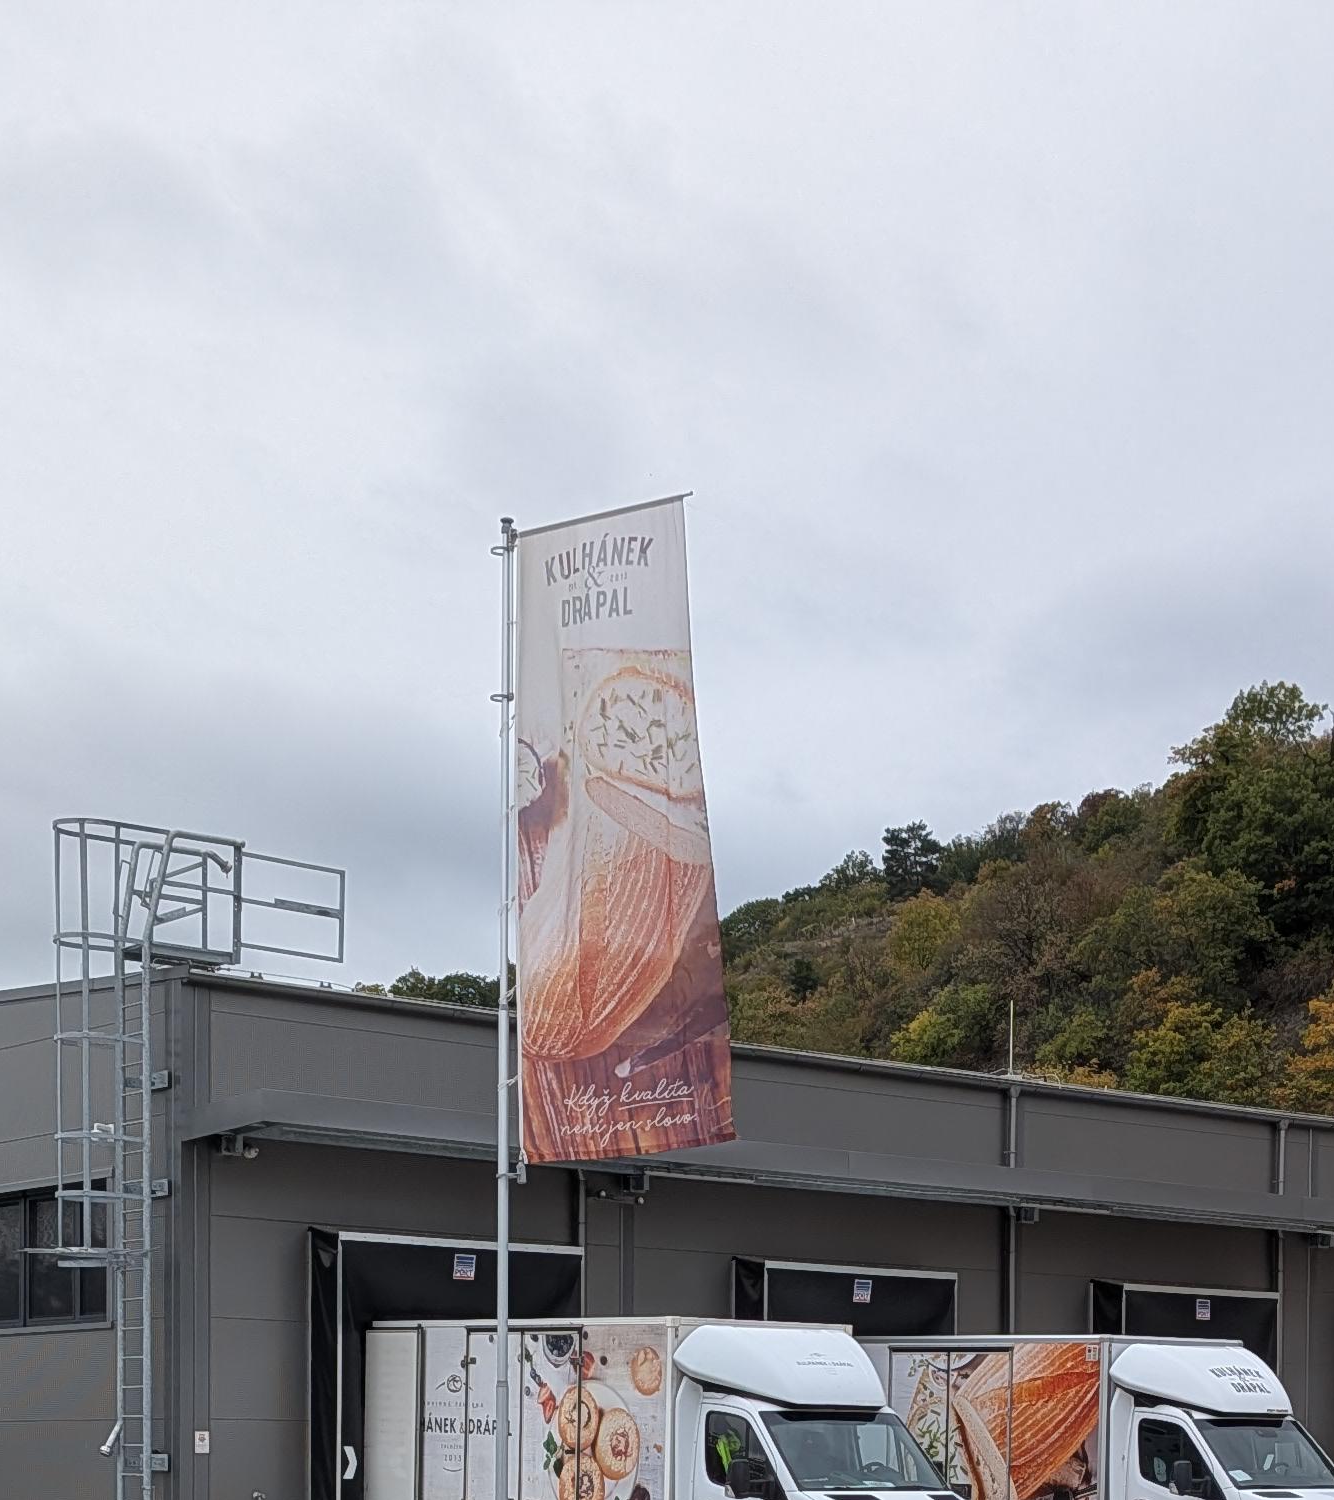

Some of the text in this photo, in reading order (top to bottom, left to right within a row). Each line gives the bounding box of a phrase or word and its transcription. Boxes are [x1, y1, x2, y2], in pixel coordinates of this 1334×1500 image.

[544, 532, 654, 587] KULHÁNEK
[584, 565, 605, 589] &
[561, 586, 633, 628] DRÁPAL
[563, 1077, 695, 1118] Když kvalita
[560, 1117, 607, 1136] není
[599, 1119, 643, 1147] jen
[1208, 1366, 1265, 1379] KULHÁNEK
[1230, 1381, 1272, 1394] DRÁPAL
[468, 1414, 513, 1437] DRÁPL
